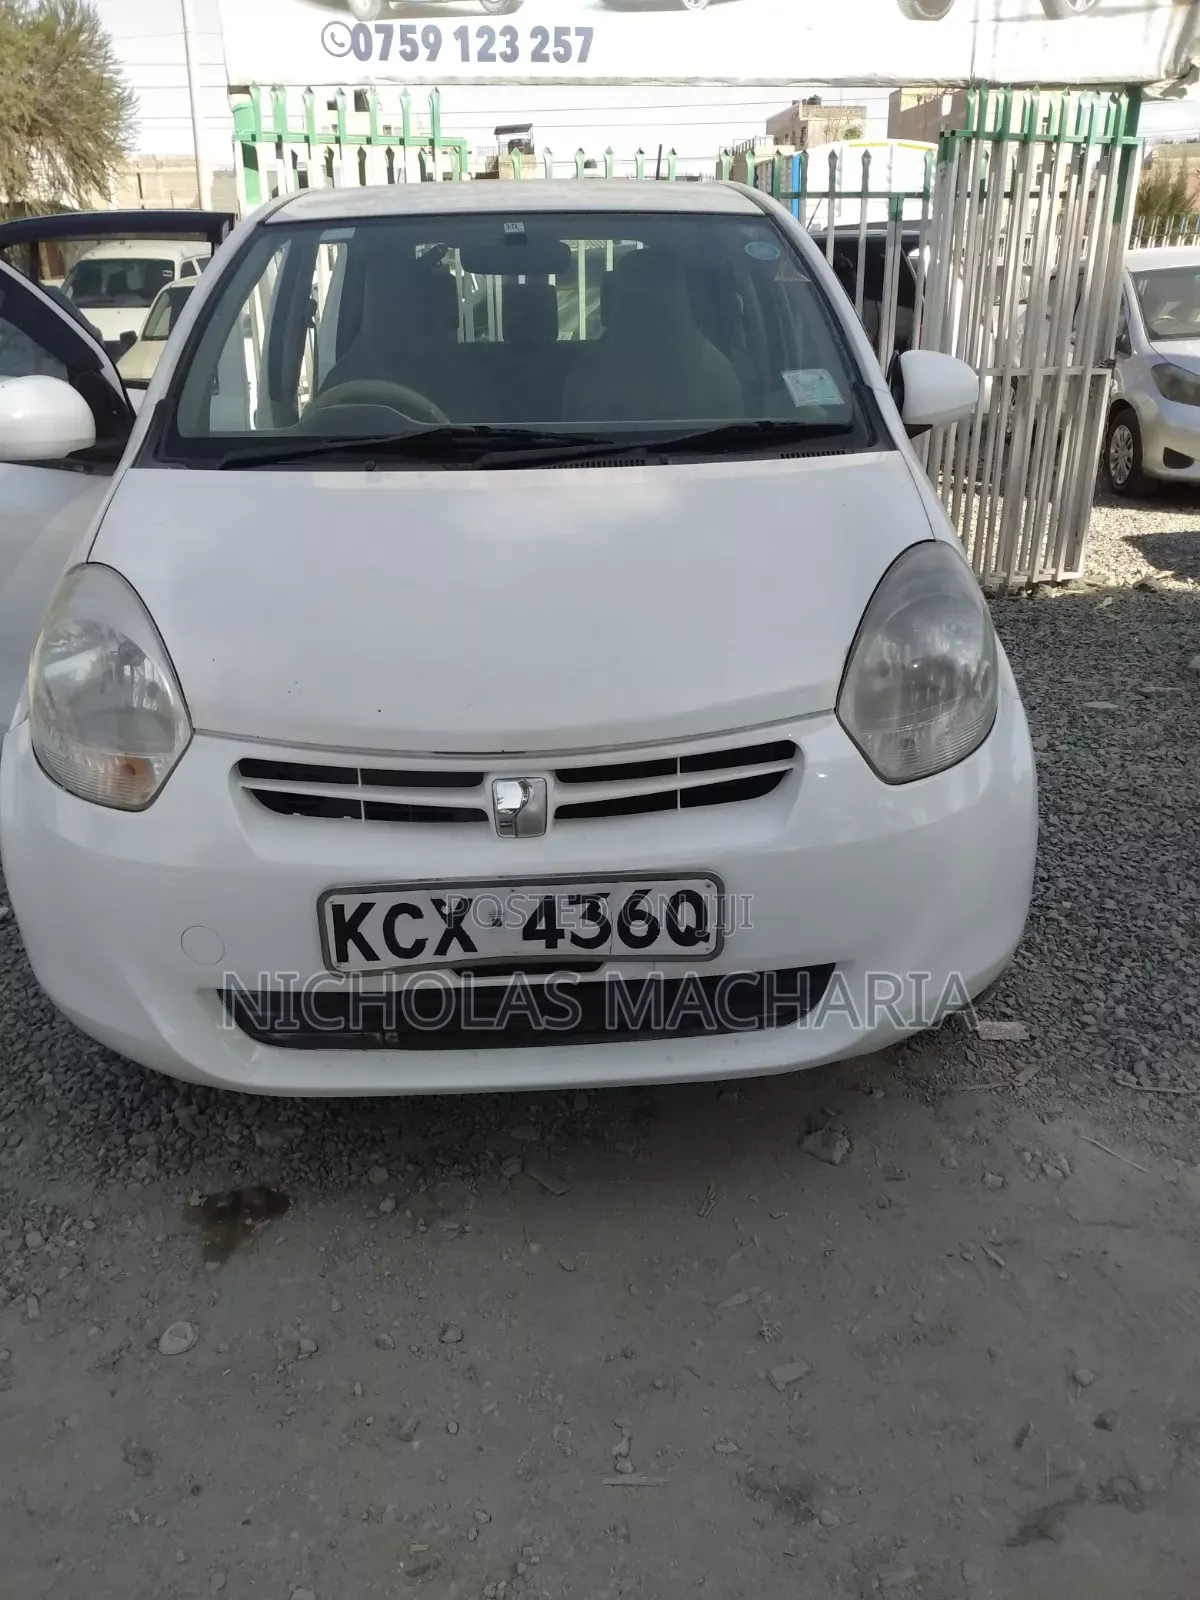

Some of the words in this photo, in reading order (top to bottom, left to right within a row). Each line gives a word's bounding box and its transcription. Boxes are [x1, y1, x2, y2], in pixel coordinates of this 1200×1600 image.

[351, 22, 442, 62] 0759
[453, 25, 520, 63] 123
[529, 25, 594, 63] 257
[331, 898, 478, 963] KCX
[522, 888, 710, 950] 436Q
